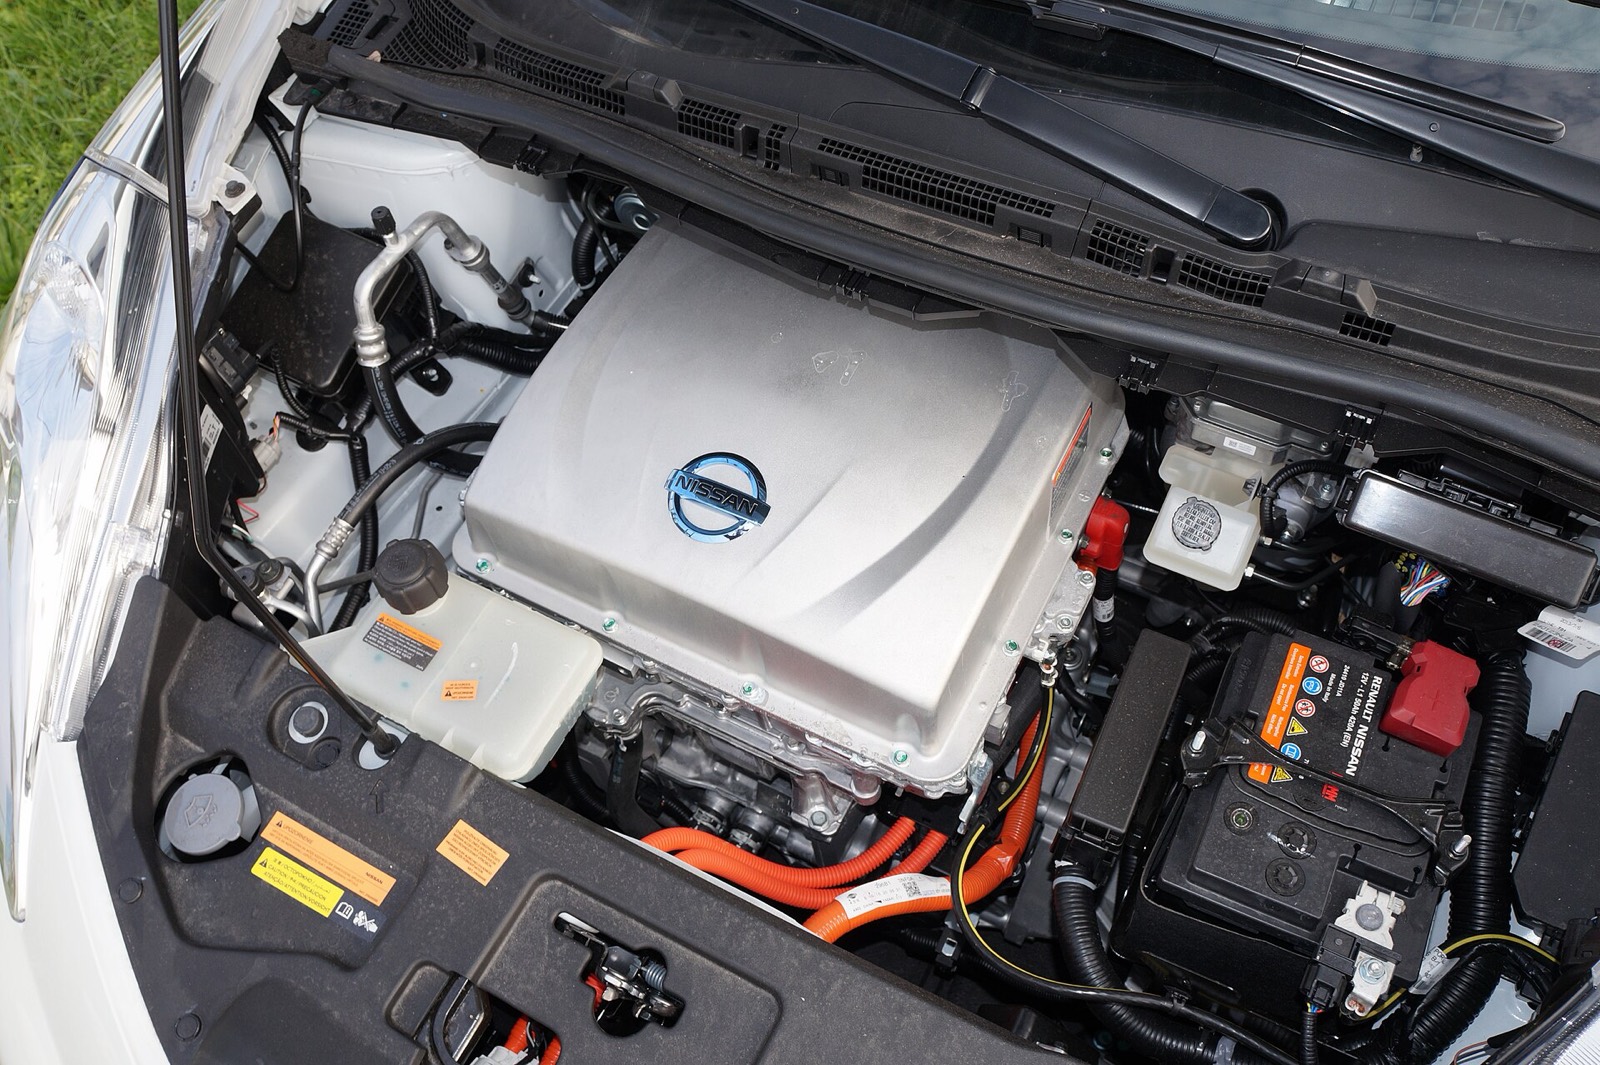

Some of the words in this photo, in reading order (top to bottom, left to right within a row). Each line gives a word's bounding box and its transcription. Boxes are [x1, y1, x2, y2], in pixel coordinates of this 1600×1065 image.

[675, 475, 758, 516] NISSAN
[1328, 673, 1337, 687] Made
[1360, 672, 1369, 685] 12V
[1322, 690, 1331, 703] Italy
[1356, 688, 1365, 698] L1
[1362, 675, 1383, 723] RENAULT
[1351, 697, 1362, 715] 50Ah
[1346, 715, 1357, 732] 420A
[1345, 723, 1369, 777] NISSAN
[268, 864, 287, 878] CAUTION
[365, 871, 384, 885] NISSAN
